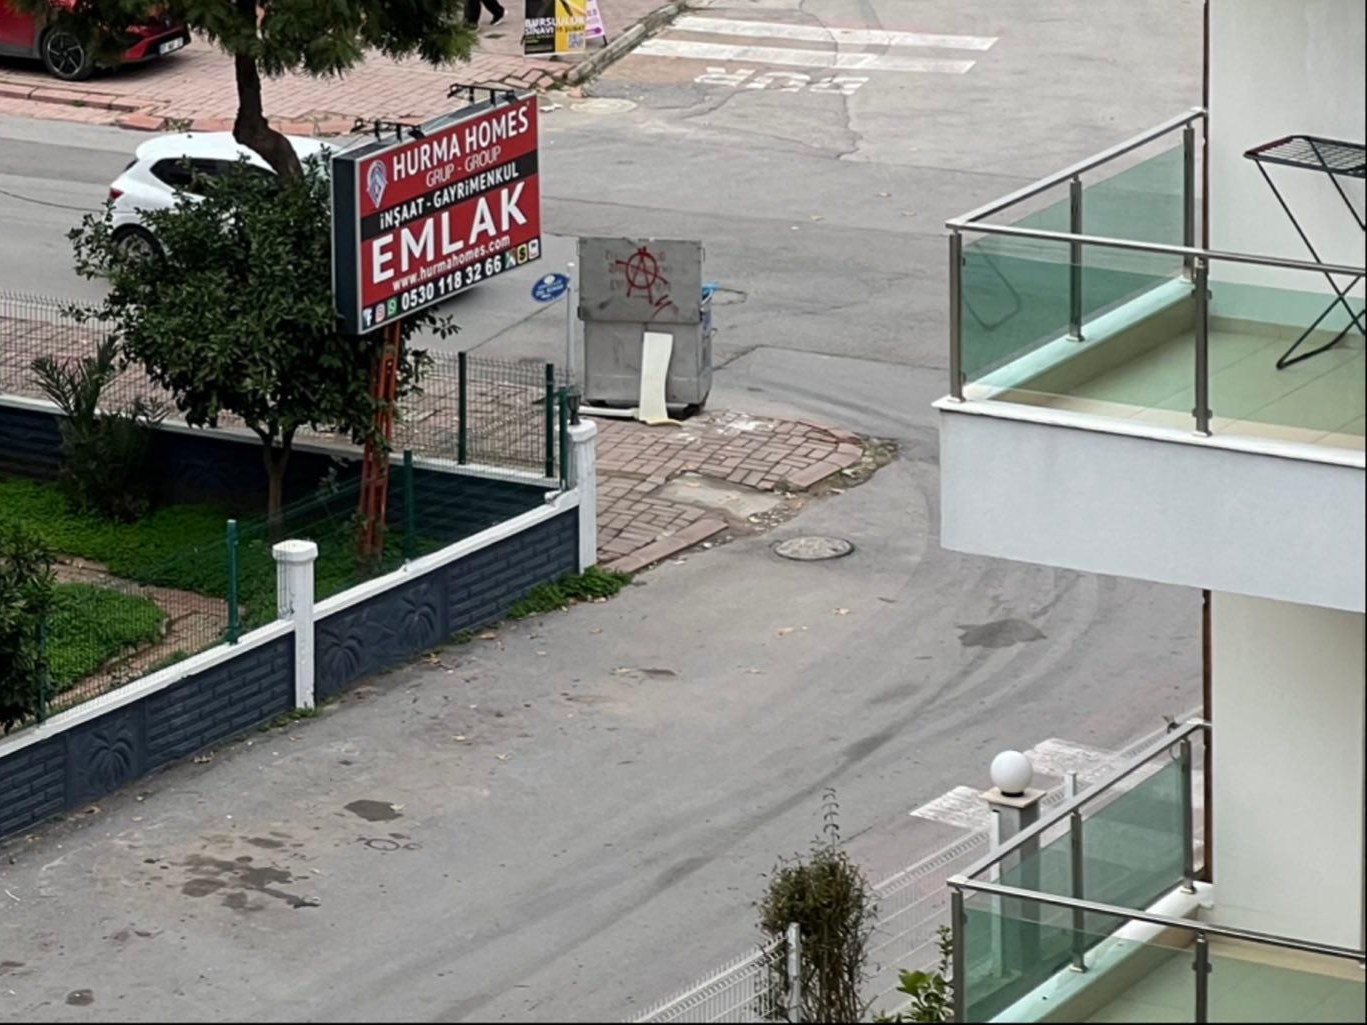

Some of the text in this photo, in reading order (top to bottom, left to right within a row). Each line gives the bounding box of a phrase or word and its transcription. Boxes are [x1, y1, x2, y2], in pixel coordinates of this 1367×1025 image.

[393, 106, 528, 181] HURMA HOMES
[426, 165, 454, 187] GRUP
[465, 146, 502, 173] GROUP
[372, 182, 527, 284] EMLAK
[393, 235, 510, 291] www.hurmahomes.com
[401, 282, 434, 311] 0530
[438, 272, 462, 295] 118
[465, 264, 481, 284] 32
[485, 255, 502, 274] 66
